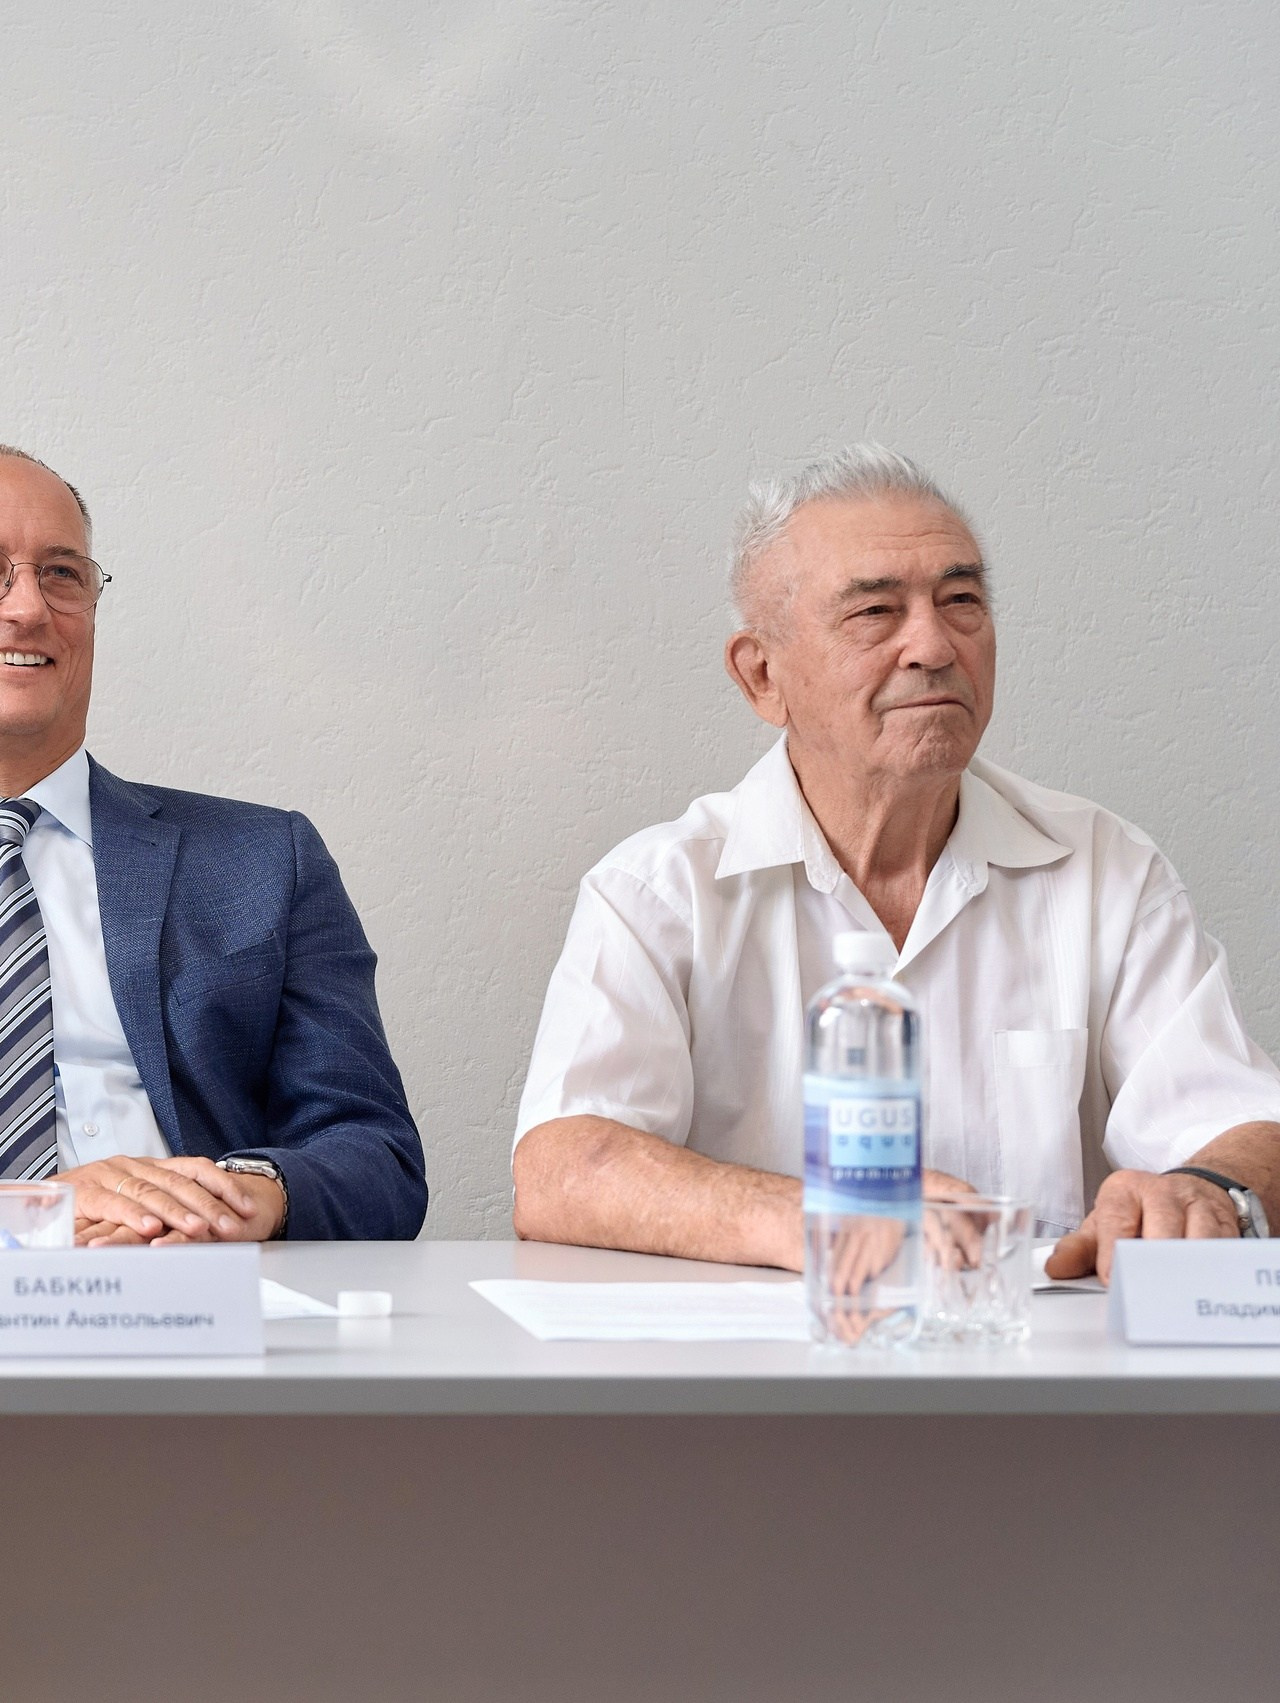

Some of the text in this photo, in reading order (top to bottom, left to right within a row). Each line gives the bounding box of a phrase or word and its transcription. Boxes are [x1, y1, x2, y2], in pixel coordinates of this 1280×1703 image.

[835, 1107, 913, 1128] UGUS
[14, 1277, 122, 1296] БАБКИН
[65, 1310, 215, 1330] Анатольевич
